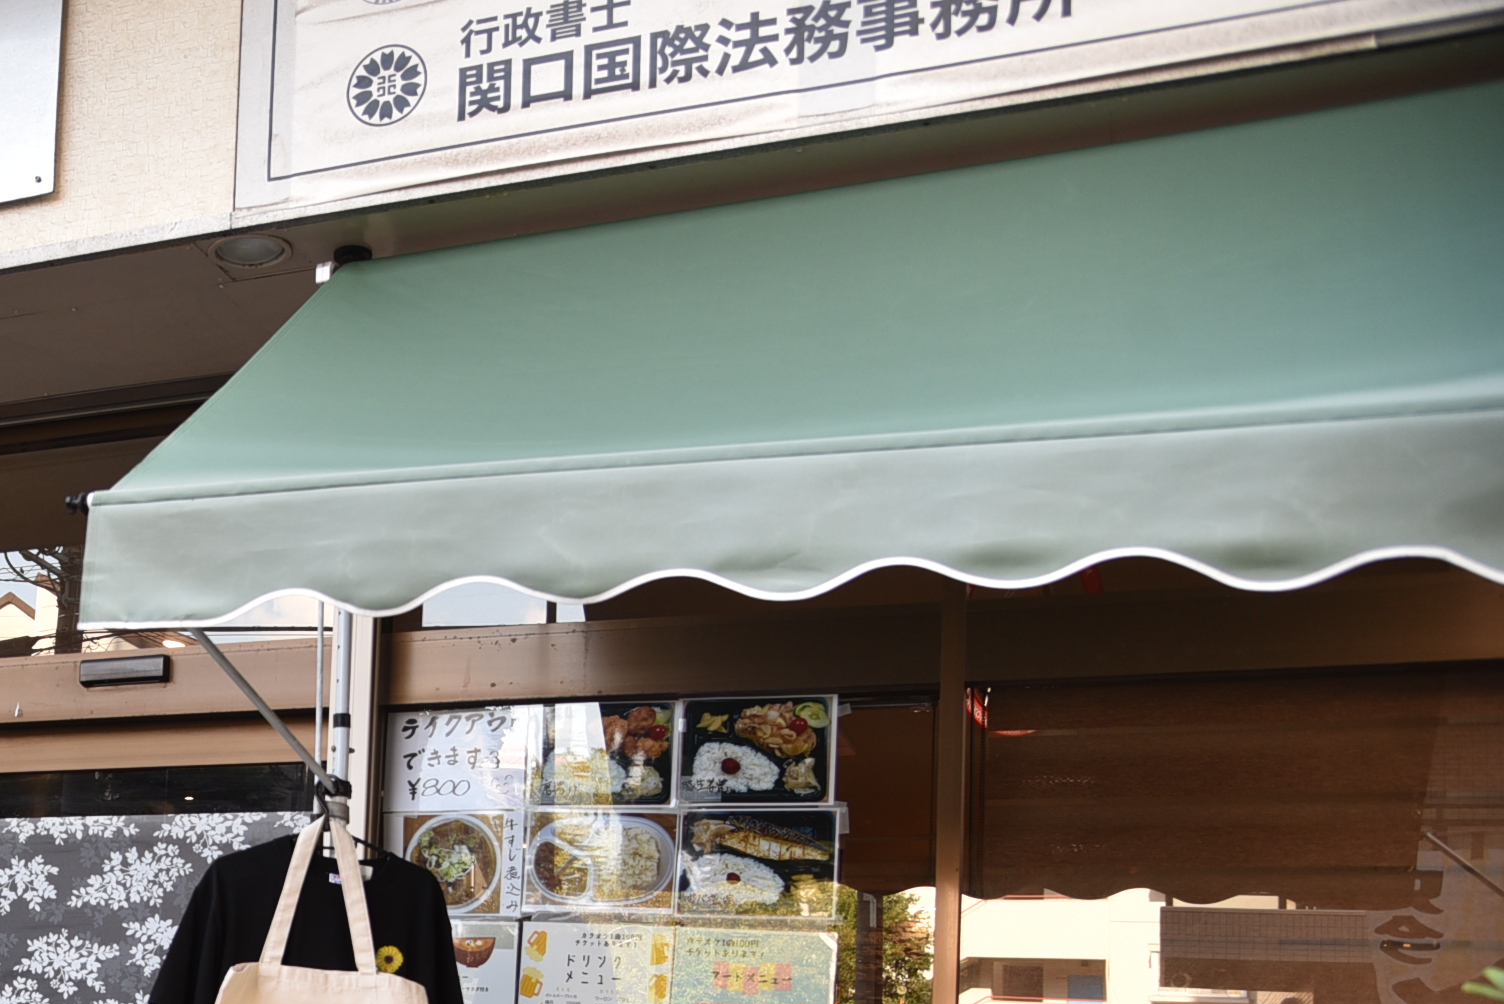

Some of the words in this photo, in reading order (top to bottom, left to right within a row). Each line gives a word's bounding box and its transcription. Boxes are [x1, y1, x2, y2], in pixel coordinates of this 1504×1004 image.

[459, 0, 632, 59] 行政書士
[407, 777, 471, 801] ¥800
[566, 954, 622, 968] ドリンク
[565, 970, 622, 985] メニュー
